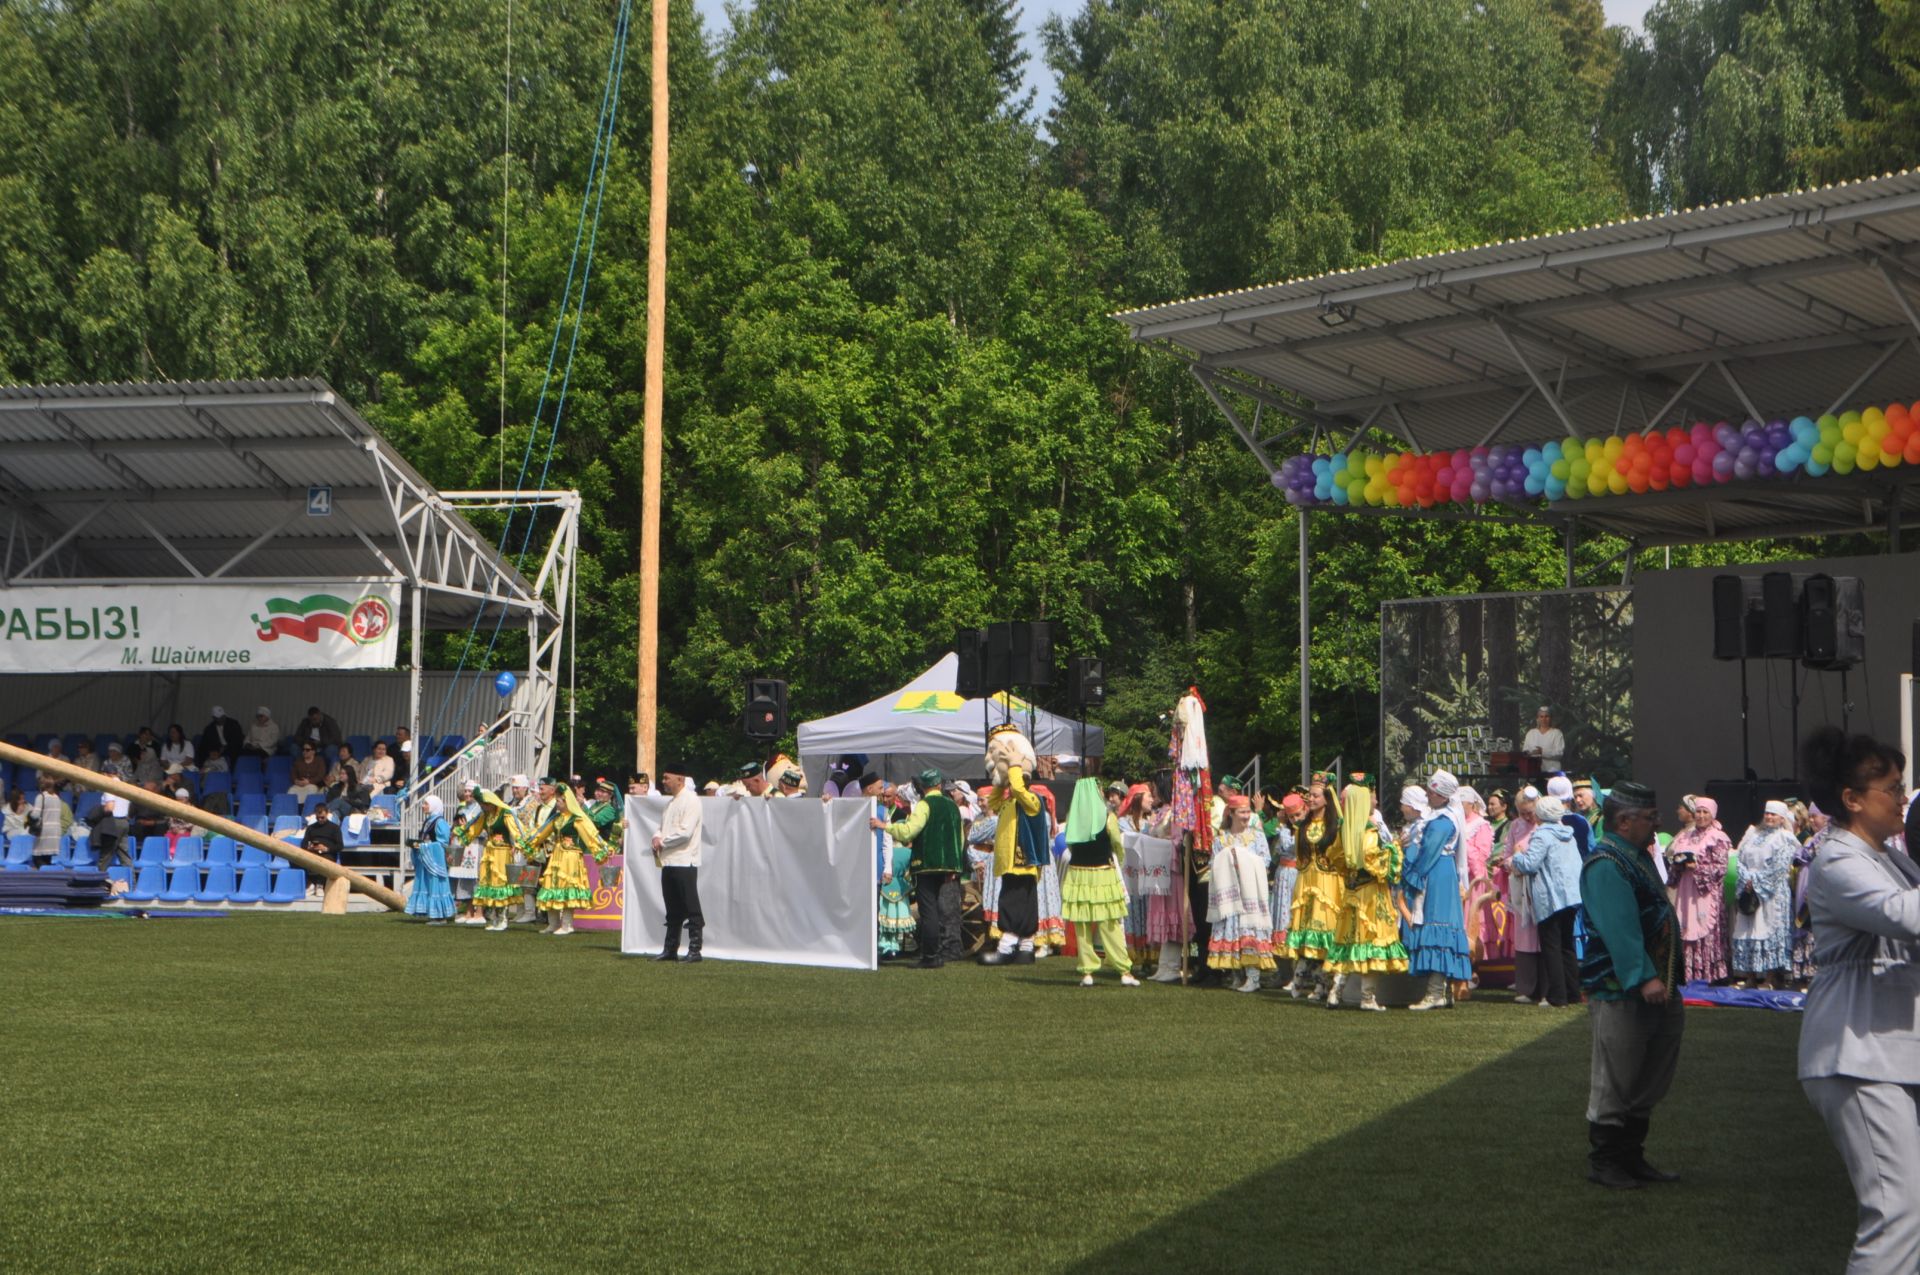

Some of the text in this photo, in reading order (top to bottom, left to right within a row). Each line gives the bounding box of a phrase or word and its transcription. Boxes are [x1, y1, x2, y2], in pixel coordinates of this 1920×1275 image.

[310, 490, 329, 512] 4
[0, 606, 140, 640] АБЫЗ!
[121, 646, 251, 664] М. Шаймиев
